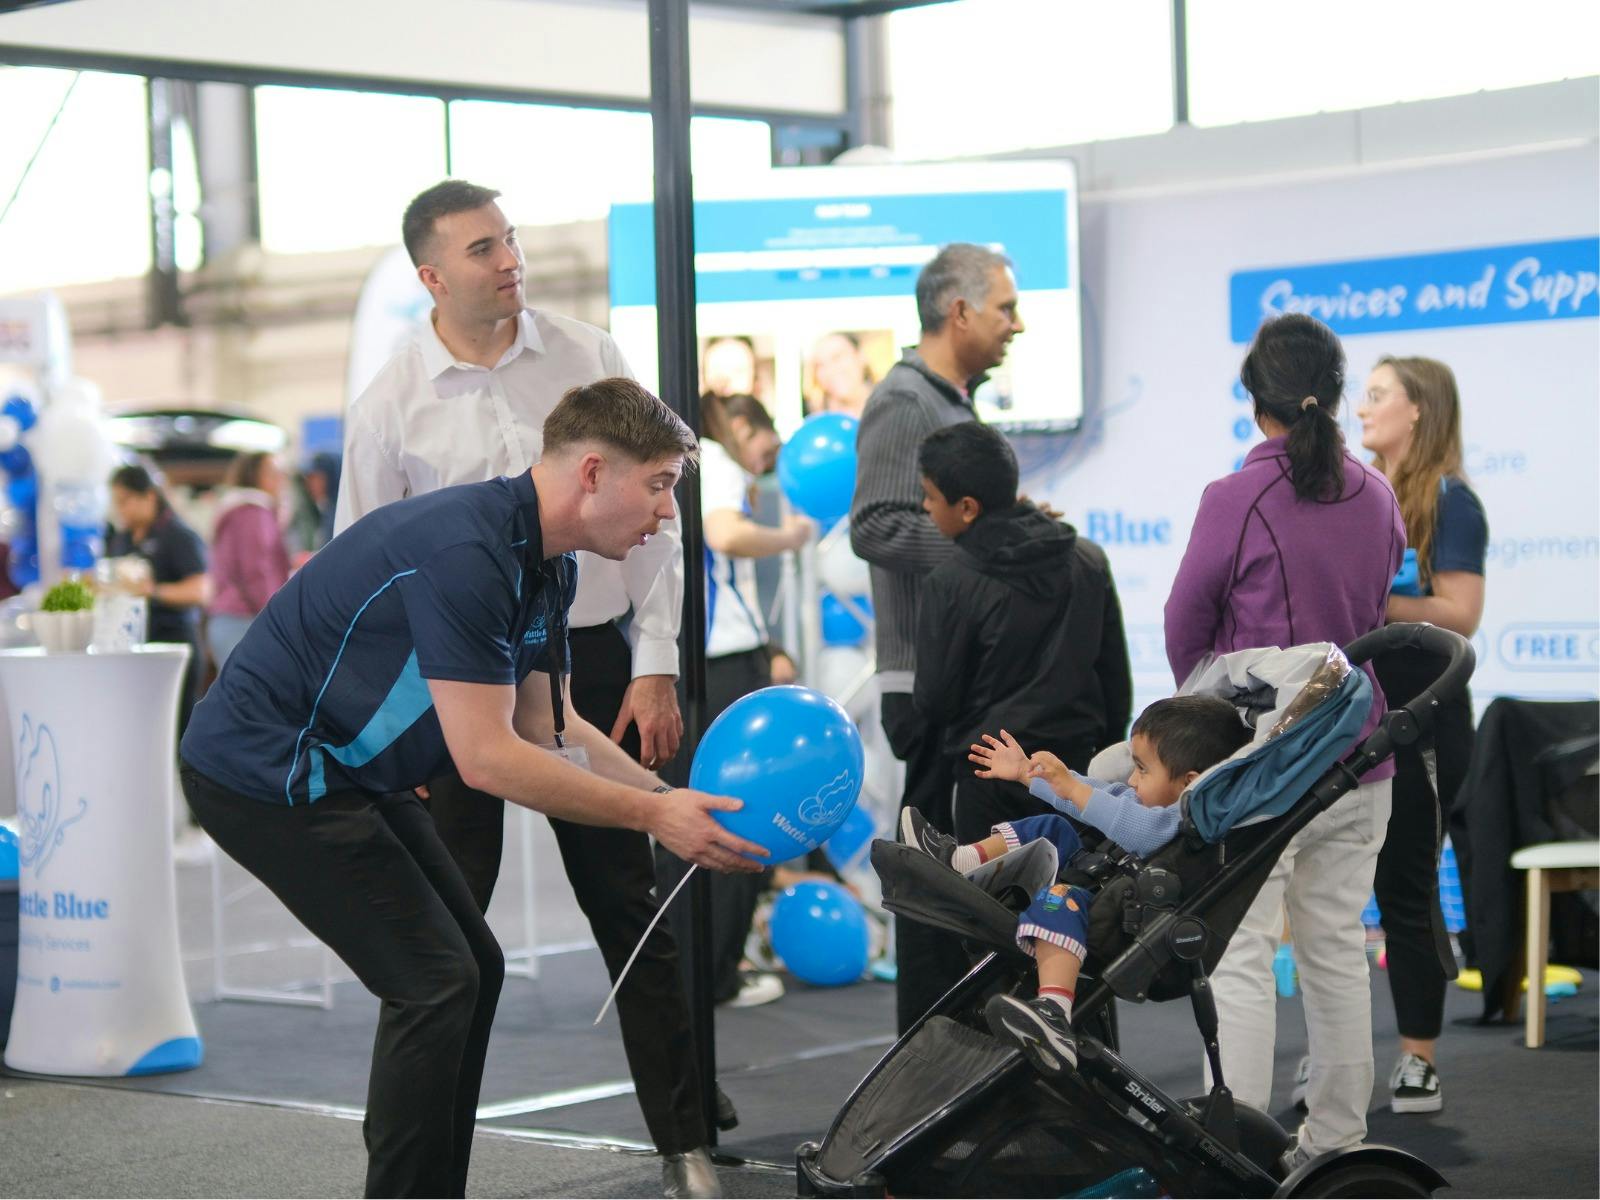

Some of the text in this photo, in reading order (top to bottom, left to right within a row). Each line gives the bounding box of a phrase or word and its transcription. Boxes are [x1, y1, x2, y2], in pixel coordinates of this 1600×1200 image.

[1260, 257, 1599, 319] Services and Supp
[1087, 509, 1172, 546] Blue
[1487, 531, 1599, 569] agemen
[1514, 633, 1579, 660] FREE
[772, 811, 808, 843] Wattle
[19, 892, 109, 919] ttle Blue
[1125, 1081, 1166, 1114] Strider
